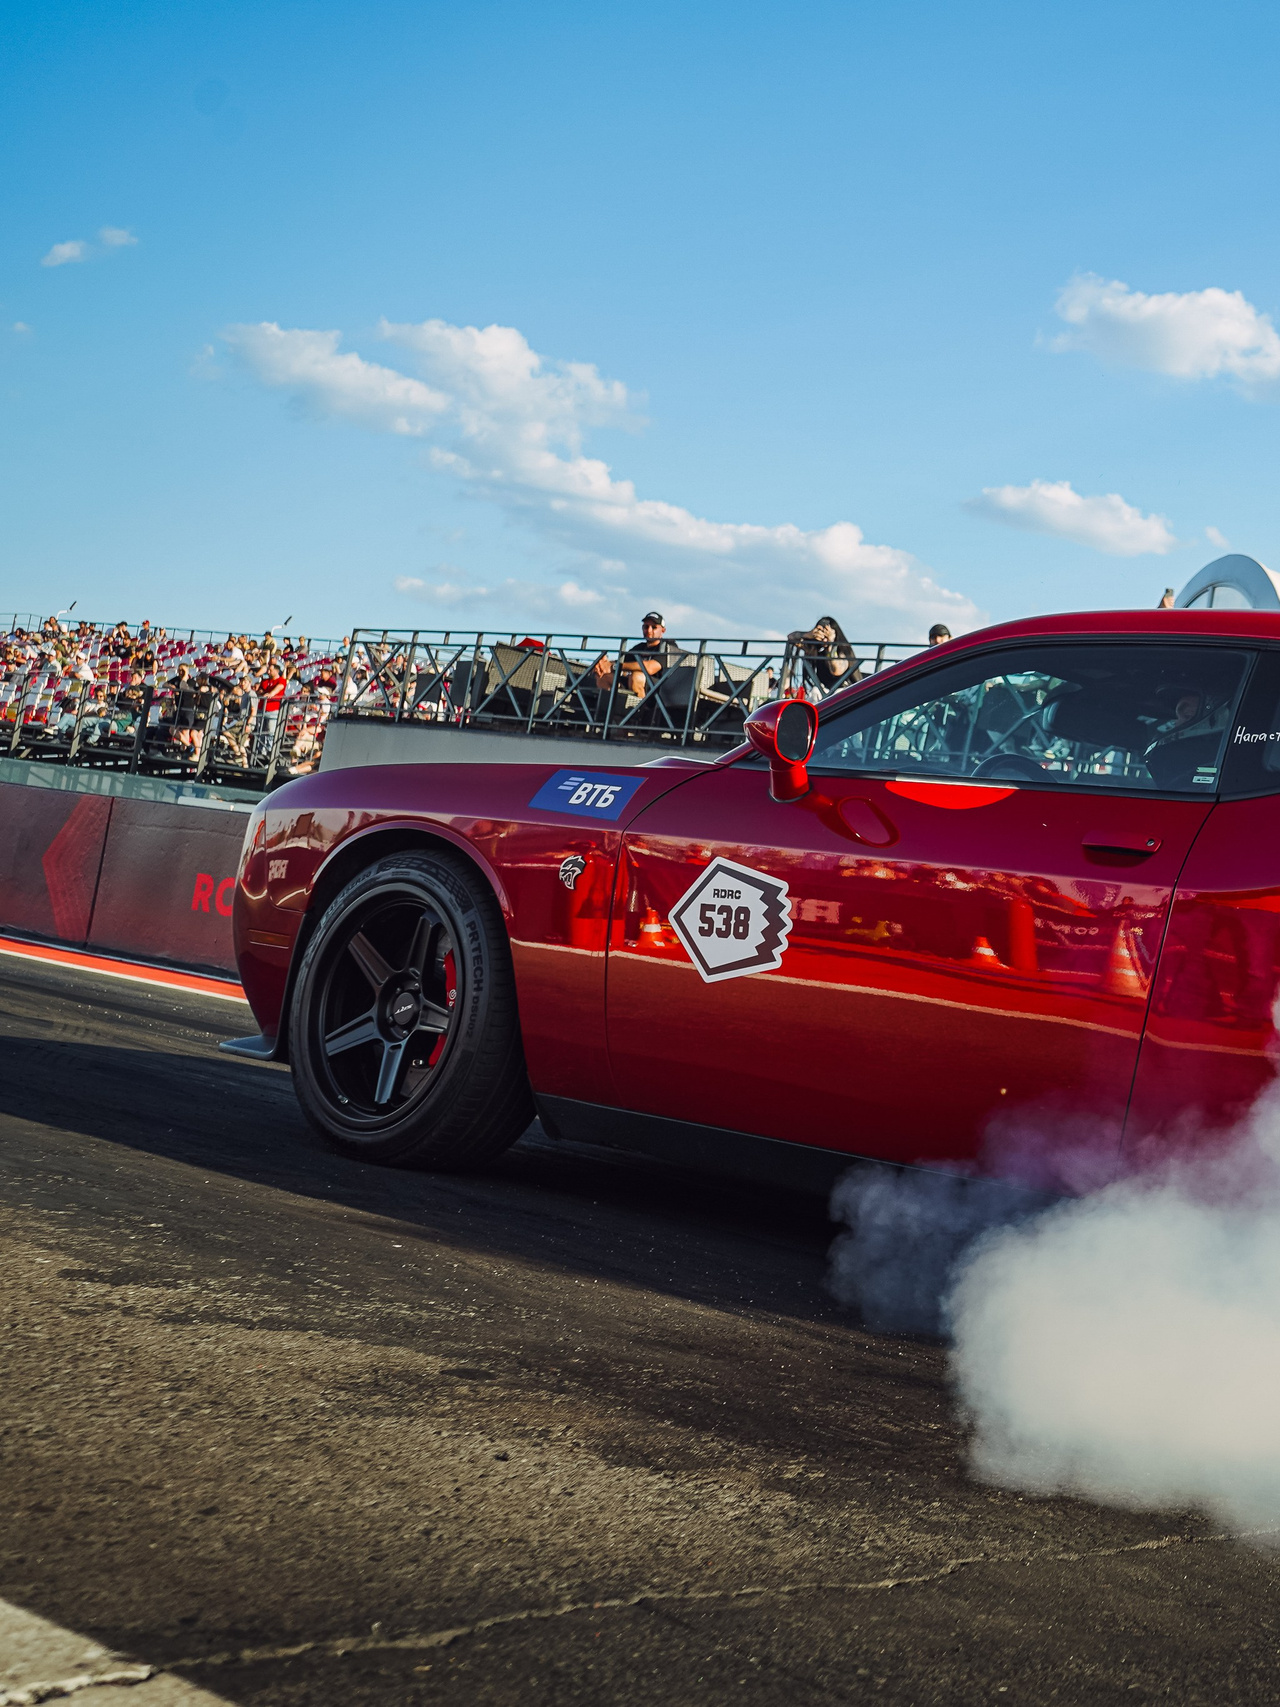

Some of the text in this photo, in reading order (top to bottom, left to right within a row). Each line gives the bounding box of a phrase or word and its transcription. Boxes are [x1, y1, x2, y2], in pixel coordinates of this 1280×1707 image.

[568, 782, 623, 809] ВТБ
[712, 888, 742, 900] RDRC
[698, 903, 751, 940] 538
